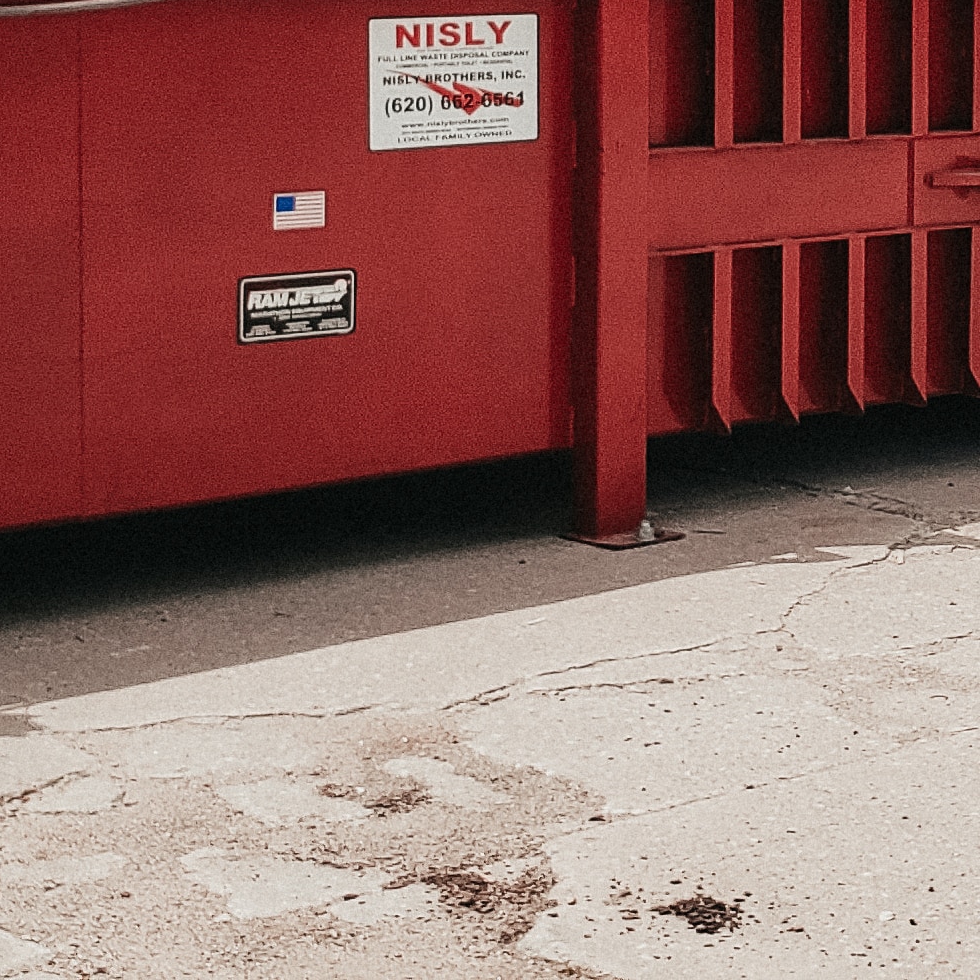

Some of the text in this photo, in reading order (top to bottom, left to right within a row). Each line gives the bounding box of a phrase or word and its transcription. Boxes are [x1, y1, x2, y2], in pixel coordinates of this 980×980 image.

[395, 20, 512, 49] NISLY
[378, 55, 397, 63] FULL
[420, 53, 447, 61] WASTE
[450, 51, 488, 60] DISPOSAL
[491, 50, 529, 58] COMPANY
[383, 69, 526, 86] NISLY BROTHERS, INC.
[385, 95, 434, 118] (620)
[435, 131, 471, 141] FAMILY
